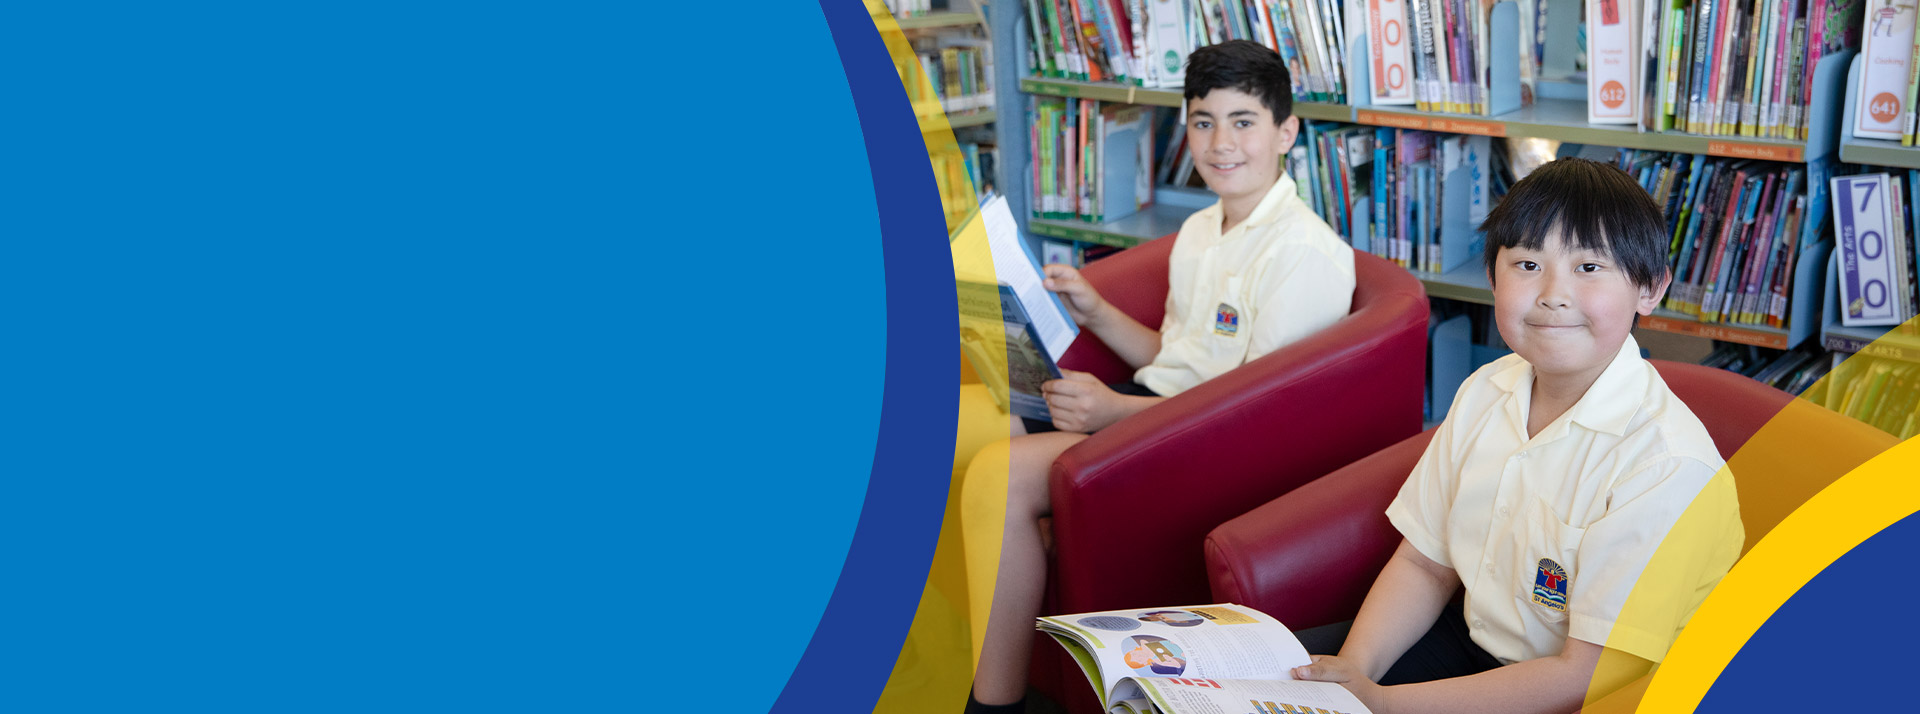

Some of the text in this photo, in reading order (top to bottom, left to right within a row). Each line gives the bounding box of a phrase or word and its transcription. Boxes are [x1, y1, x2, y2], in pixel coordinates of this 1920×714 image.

[1874, 57, 1905, 68] Cooking
[1600, 87, 1624, 102] 612
[1871, 101, 1897, 115] 641
[1709, 144, 1726, 154] 612
[1844, 225, 1857, 273] The Arts
[1854, 182, 1887, 309] 700
[1828, 339, 1903, 359] 700 THE ARTS
